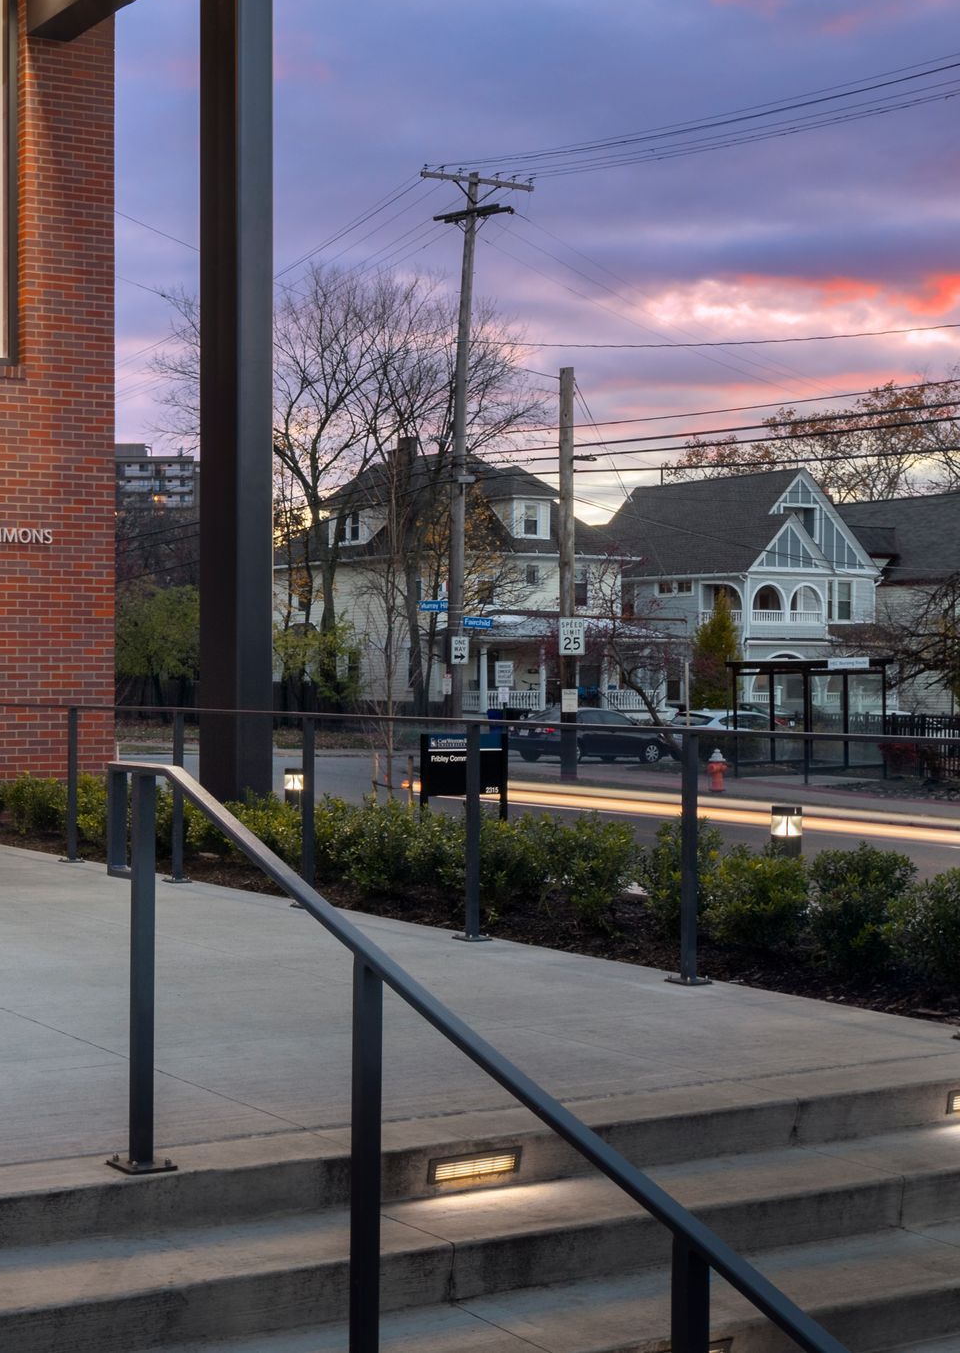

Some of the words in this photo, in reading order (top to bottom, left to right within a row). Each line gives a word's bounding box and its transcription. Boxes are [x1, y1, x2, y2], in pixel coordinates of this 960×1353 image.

[464, 617, 491, 627] Fairchild
[563, 637, 581, 650] 25
[430, 755, 450, 764] Fribley
[485, 786, 499, 794] 2315
